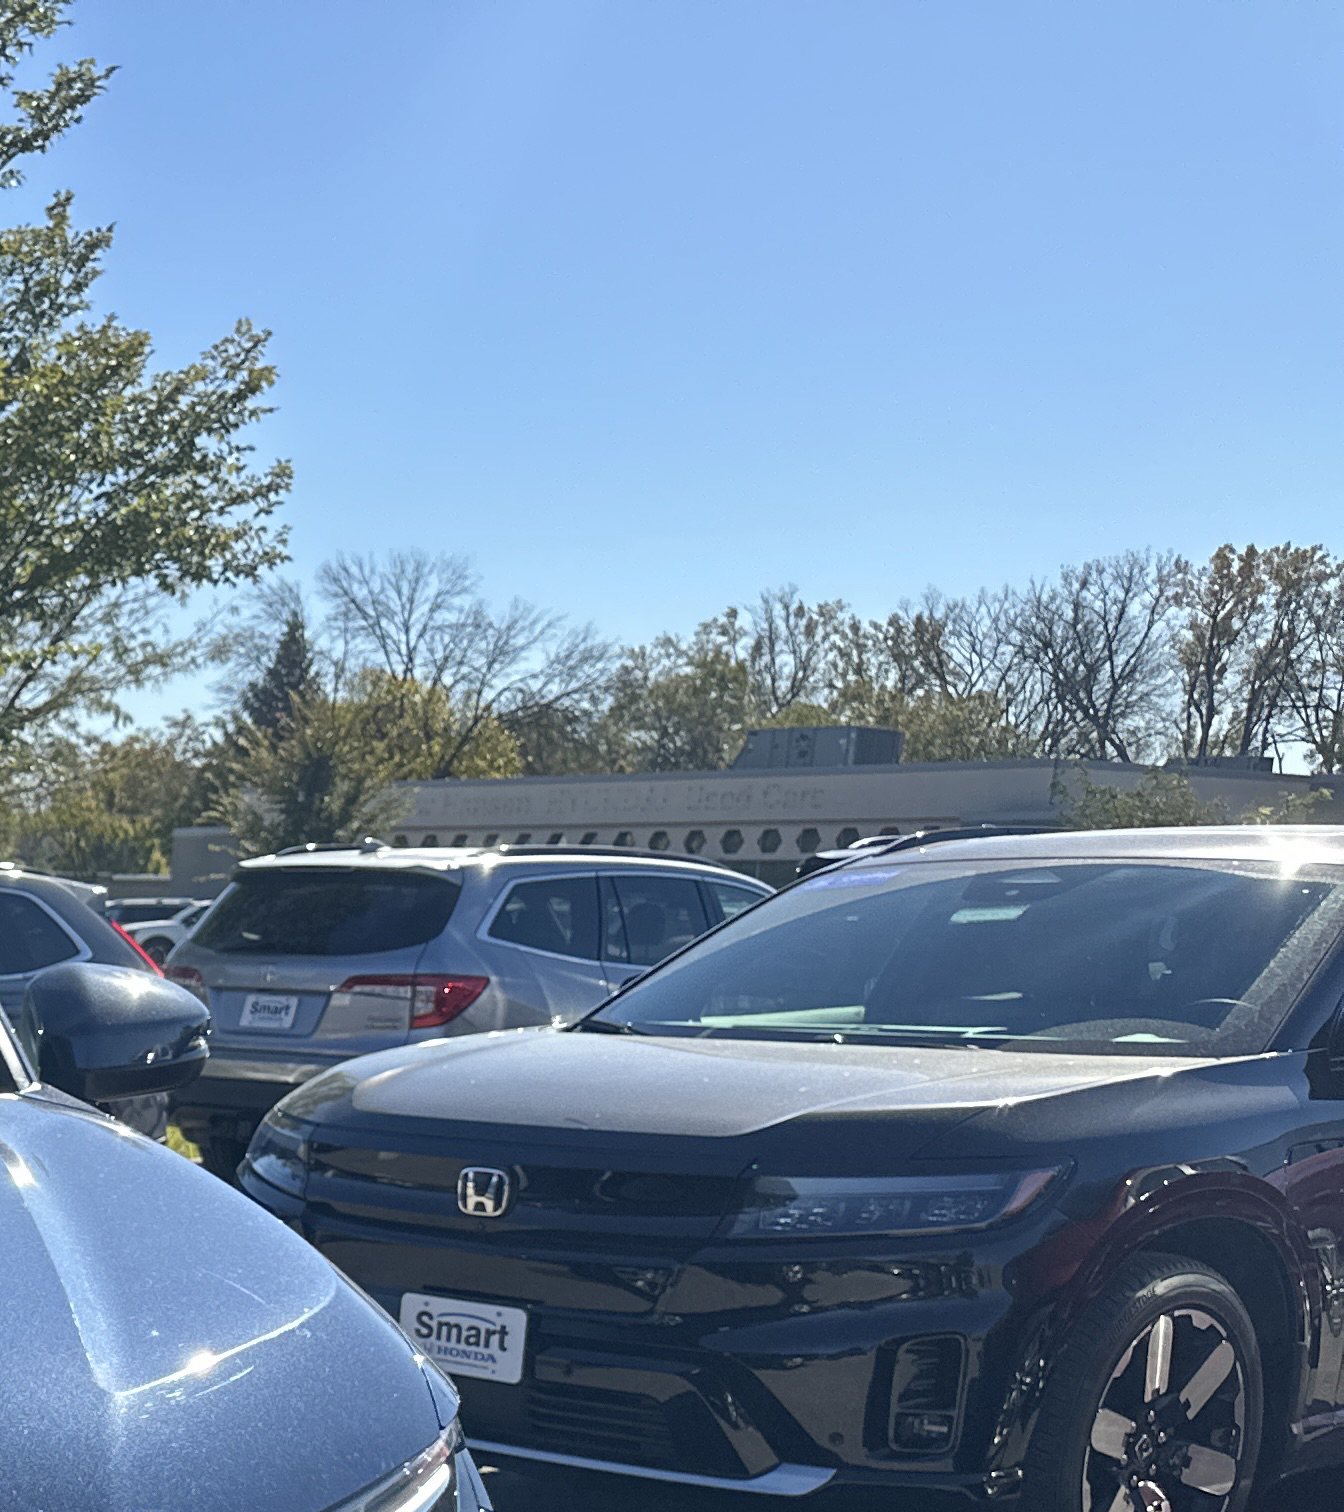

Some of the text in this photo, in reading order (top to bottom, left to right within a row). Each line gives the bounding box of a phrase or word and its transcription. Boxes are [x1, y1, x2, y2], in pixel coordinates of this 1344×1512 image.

[249, 1001, 291, 1017] Smart
[414, 1310, 509, 1352] Smart
[436, 1346, 497, 1363] HONDA
